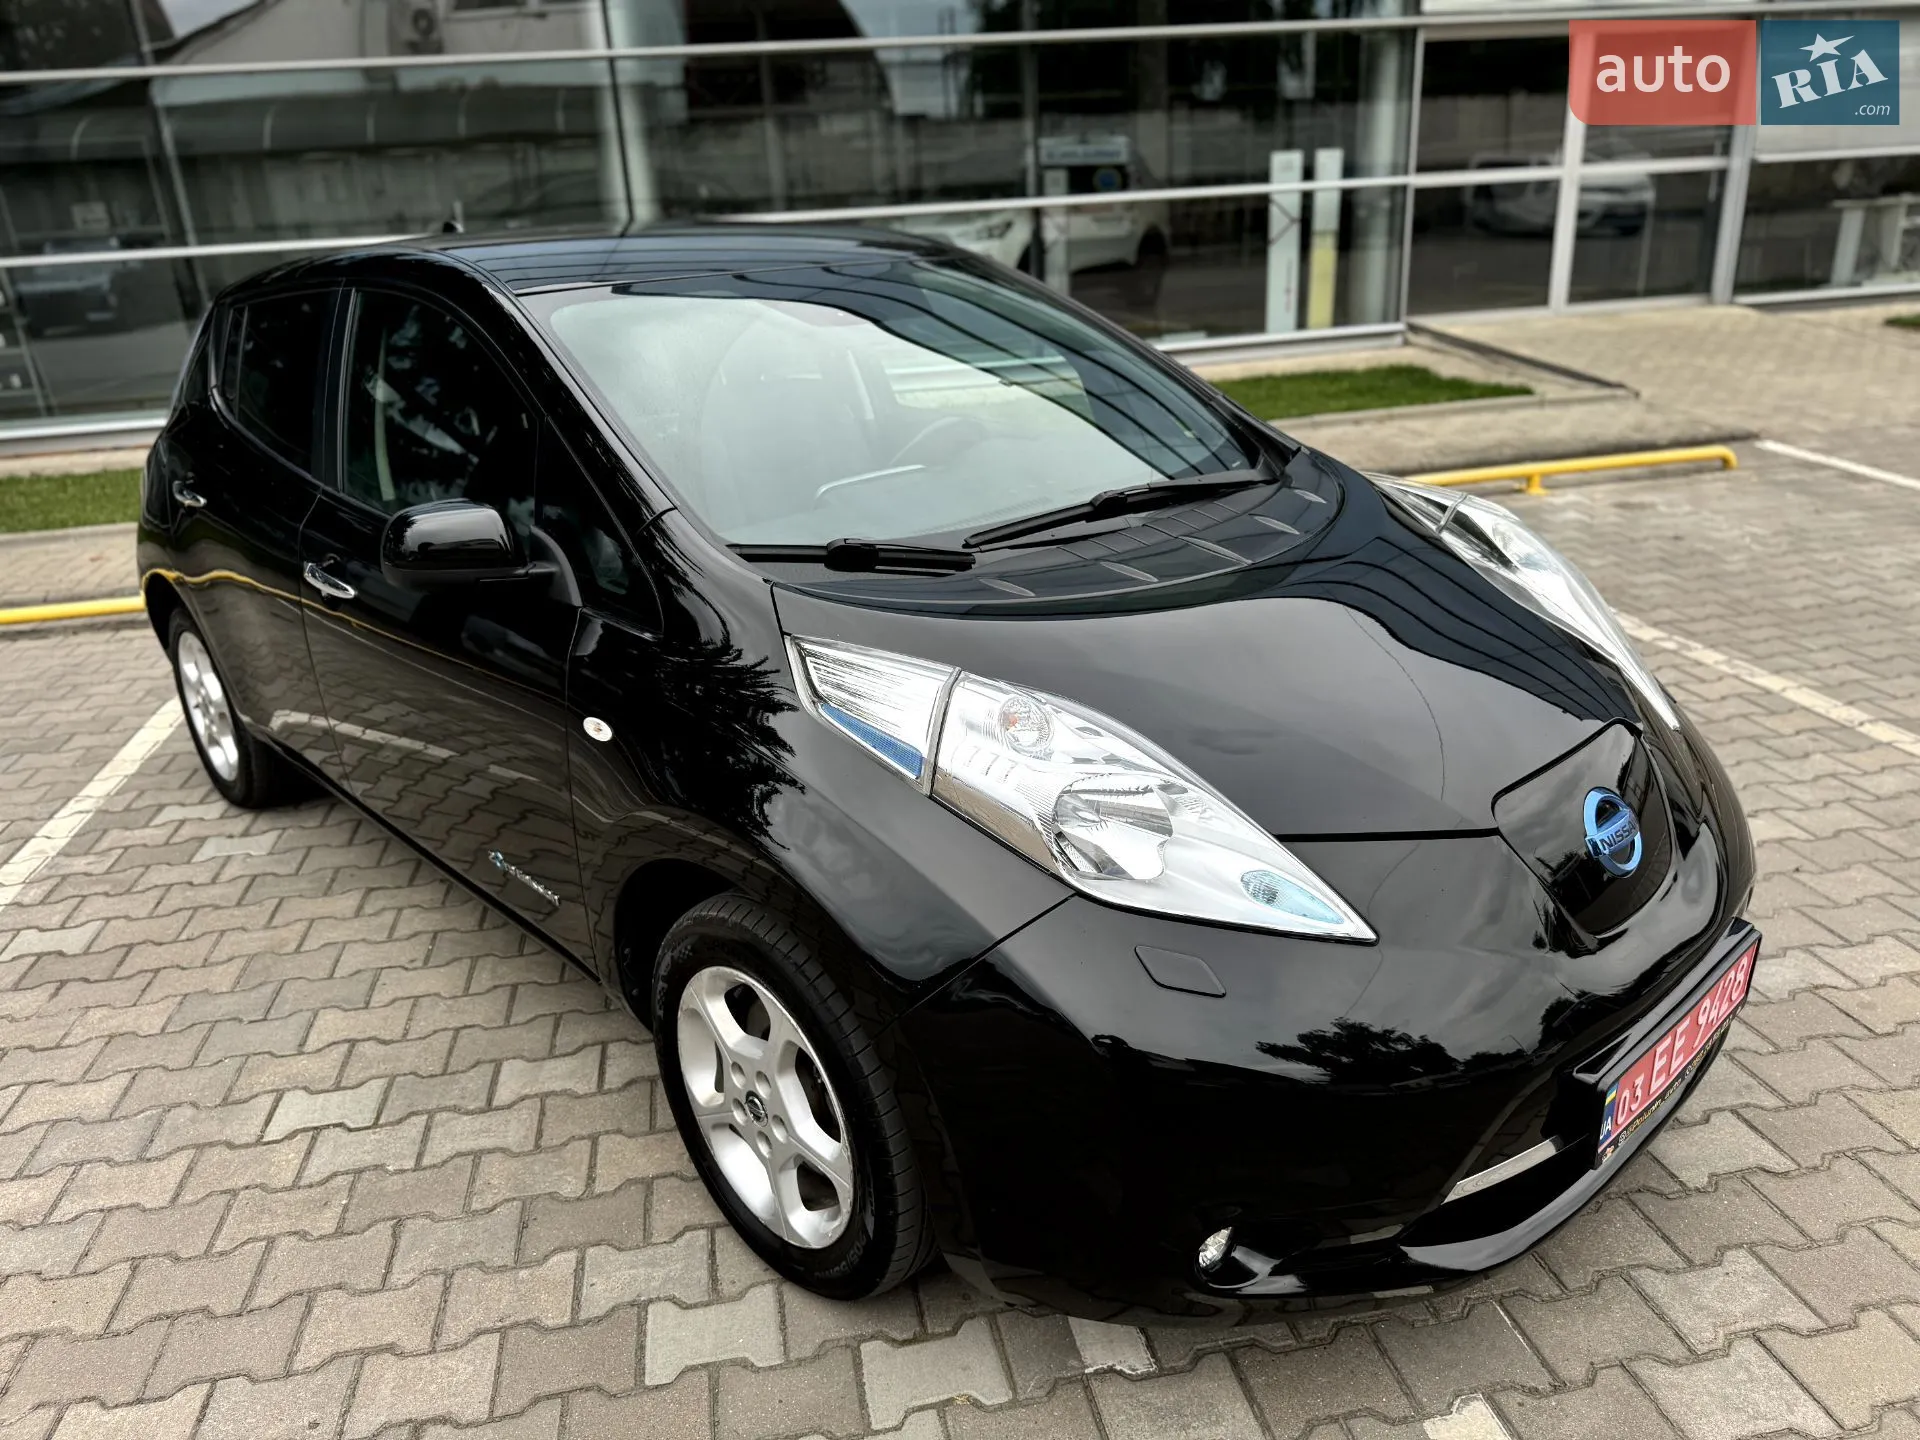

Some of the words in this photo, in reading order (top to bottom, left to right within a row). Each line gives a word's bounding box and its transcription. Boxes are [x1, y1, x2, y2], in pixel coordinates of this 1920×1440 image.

[1599, 819, 1637, 851] NISSA
[1617, 1073, 1645, 1125] 03
[1649, 1016, 1691, 1095] EE
[1693, 956, 1748, 1049] 9428
[1600, 1116, 1612, 1140] UA
